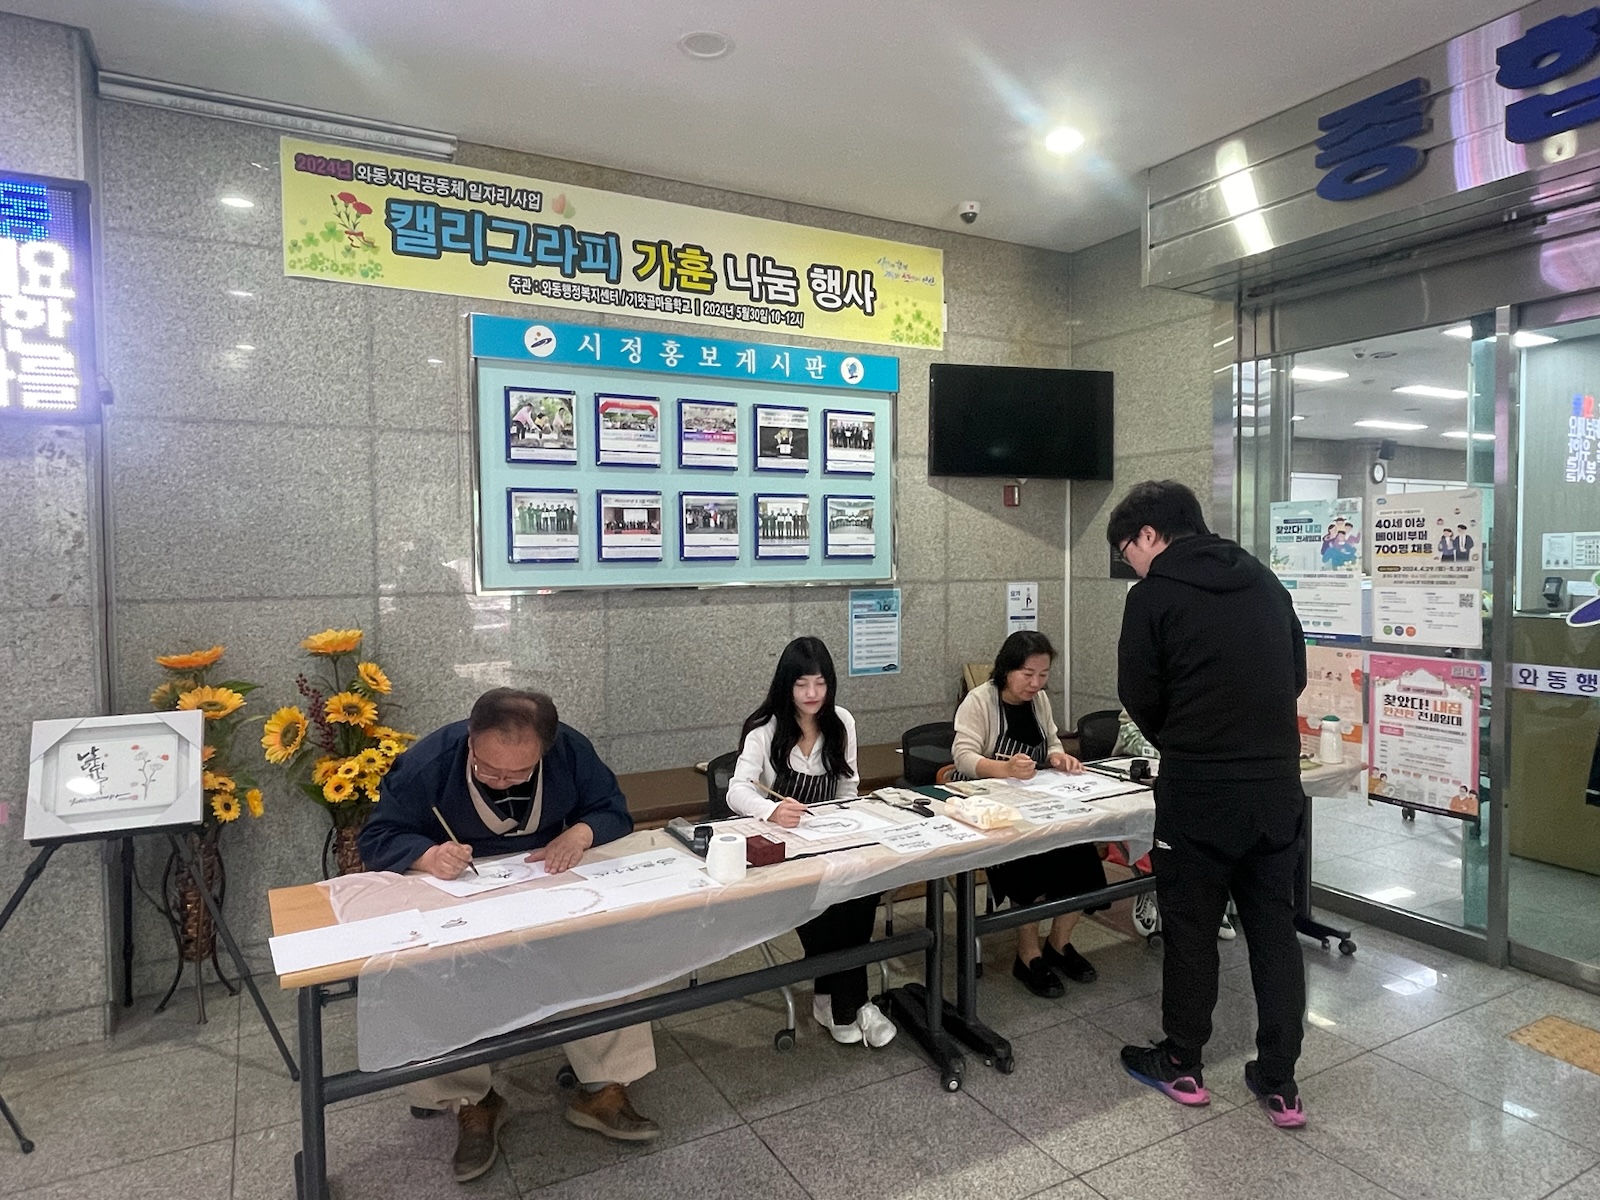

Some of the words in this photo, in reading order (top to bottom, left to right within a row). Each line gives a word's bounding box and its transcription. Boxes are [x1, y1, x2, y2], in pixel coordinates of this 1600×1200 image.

[296, 154, 353, 181] 2024년
[356, 164, 389, 185] 와동
[392, 169, 466, 200] 지역공동체
[468, 181, 511, 206] 일자리
[512, 189, 542, 212] 사업
[386, 198, 621, 283] 캘리그라피
[633, 240, 716, 292] 가훈
[724, 253, 799, 307] 나눔
[808, 263, 877, 316] 행사
[509, 275, 532, 295] 주관
[540, 280, 619, 307] 와동행정복지센터
[703, 303, 735, 322] 2024년
[769, 309, 805, 329] 10~12시
[577, 332, 827, 380] 시정홍보게시판
[1375, 518, 1403, 529] 40세
[1404, 517, 1426, 528] 이상
[1375, 530, 1428, 542] 베이비부머
[1374, 544, 1409, 555] 700명
[1411, 543, 1433, 554] 채용
[1518, 668, 1598, 693] 와동행
[1383, 694, 1429, 711] 찾았다!
[1417, 711, 1462, 727] 전세임대
